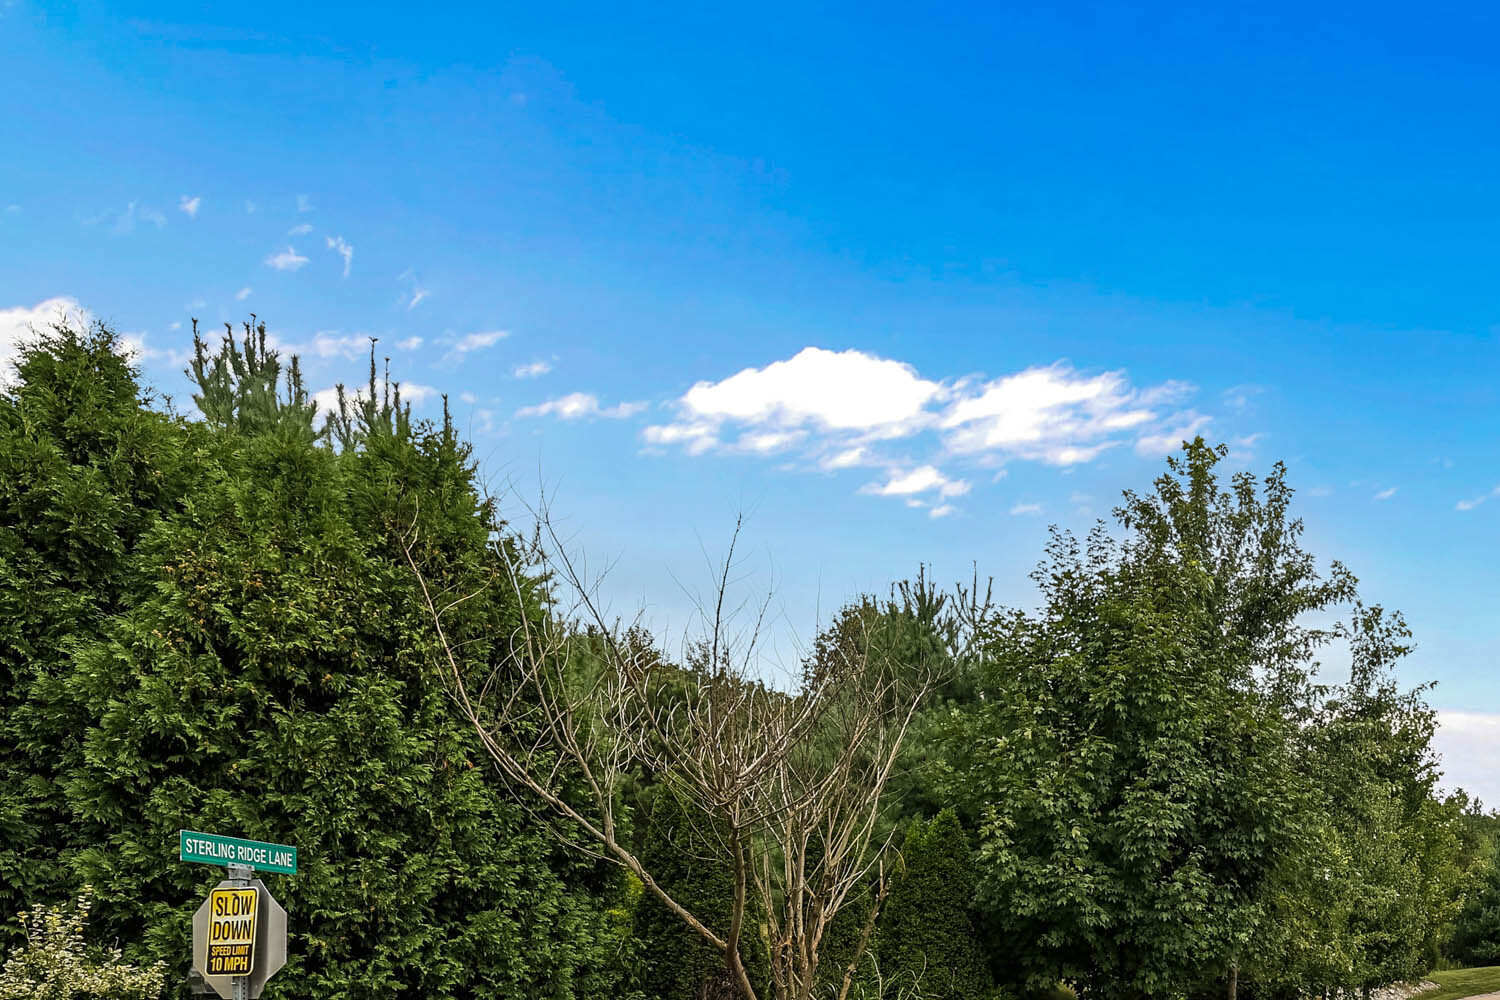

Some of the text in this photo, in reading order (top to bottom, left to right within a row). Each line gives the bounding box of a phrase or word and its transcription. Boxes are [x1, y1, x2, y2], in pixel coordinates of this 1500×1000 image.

[186, 838, 293, 867] STERLING RIDGE LANE
[215, 896, 253, 917] SLOW
[212, 920, 252, 941] DOWN
[211, 945, 250, 956] SPEED LIMIT
[211, 957, 248, 972] 10 MPH
